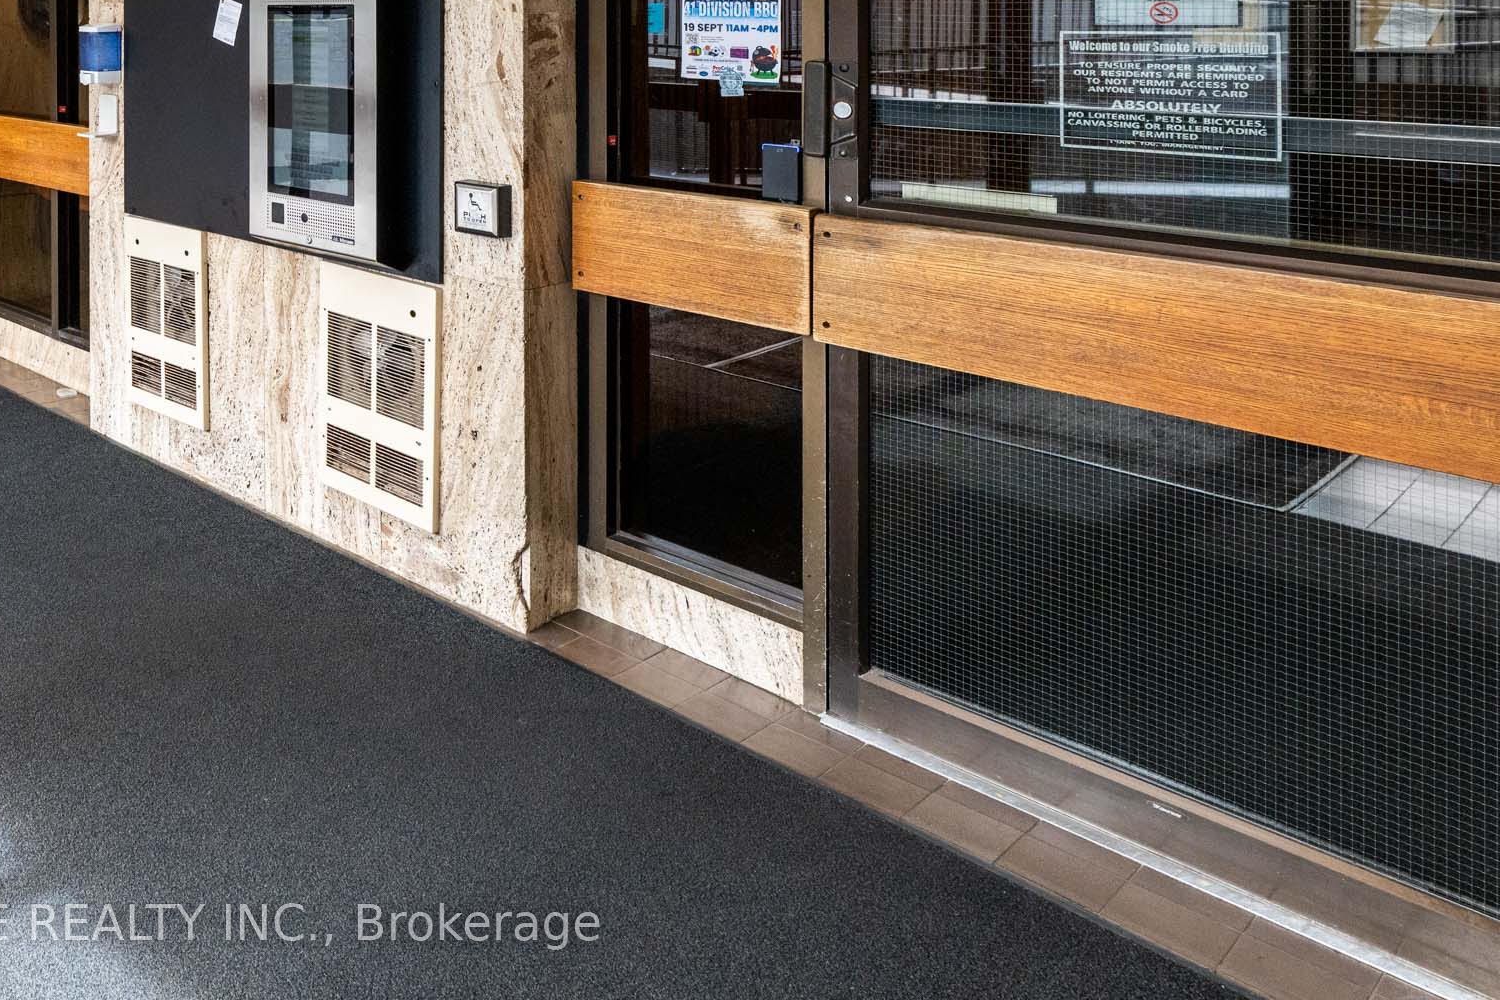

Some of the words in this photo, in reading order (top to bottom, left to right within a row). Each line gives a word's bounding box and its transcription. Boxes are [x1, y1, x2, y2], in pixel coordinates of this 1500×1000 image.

[699, 1, 750, 17] DIVISION
[754, 1, 778, 17] BBQ
[684, 23, 695, 31] 19
[697, 23, 723, 32] SEPT
[725, 24, 749, 32] 11AM
[1069, 40, 1118, 52] Welcome
[1120, 42, 1130, 52] to
[1132, 43, 1151, 52] our
[1152, 41, 1190, 53] Smoke
[1099, 62, 1141, 70] ENSURE
[1147, 63, 1191, 71] PROPER
[1197, 64, 1257, 73] SECURITY
[1073, 69, 1096, 77] OUR
[1101, 69, 1162, 79] RESIDENTS
[1167, 71, 1191, 79] ARE
[1197, 72, 1265, 82] REMINDED
[1086, 77, 1100, 85] TO
[1105, 78, 1127, 86] NOT
[1132, 79, 1175, 87] PERMIT
[1180, 80, 1228, 89] ACCESS
[1233, 81, 1249, 90] TO
[1088, 85, 1135, 94] ANYONE
[1140, 87, 1193, 96] WITHOUT
[1198, 88, 1207, 97] A
[1211, 89, 1248, 98] CARD
[1111, 99, 1221, 114] ABSOLUTELY
[1088, 111, 1149, 122] LOITERING,
[1155, 115, 1183, 124] PETS
[1188, 116, 1197, 124] &
[1067, 118, 1140, 129] CANVASSING
[1146, 122, 1161, 131] OR
[1166, 124, 1267, 136] ROLLERBLADING
[1132, 130, 1198, 141] PERMITTED
[463, 211, 486, 219] PH
